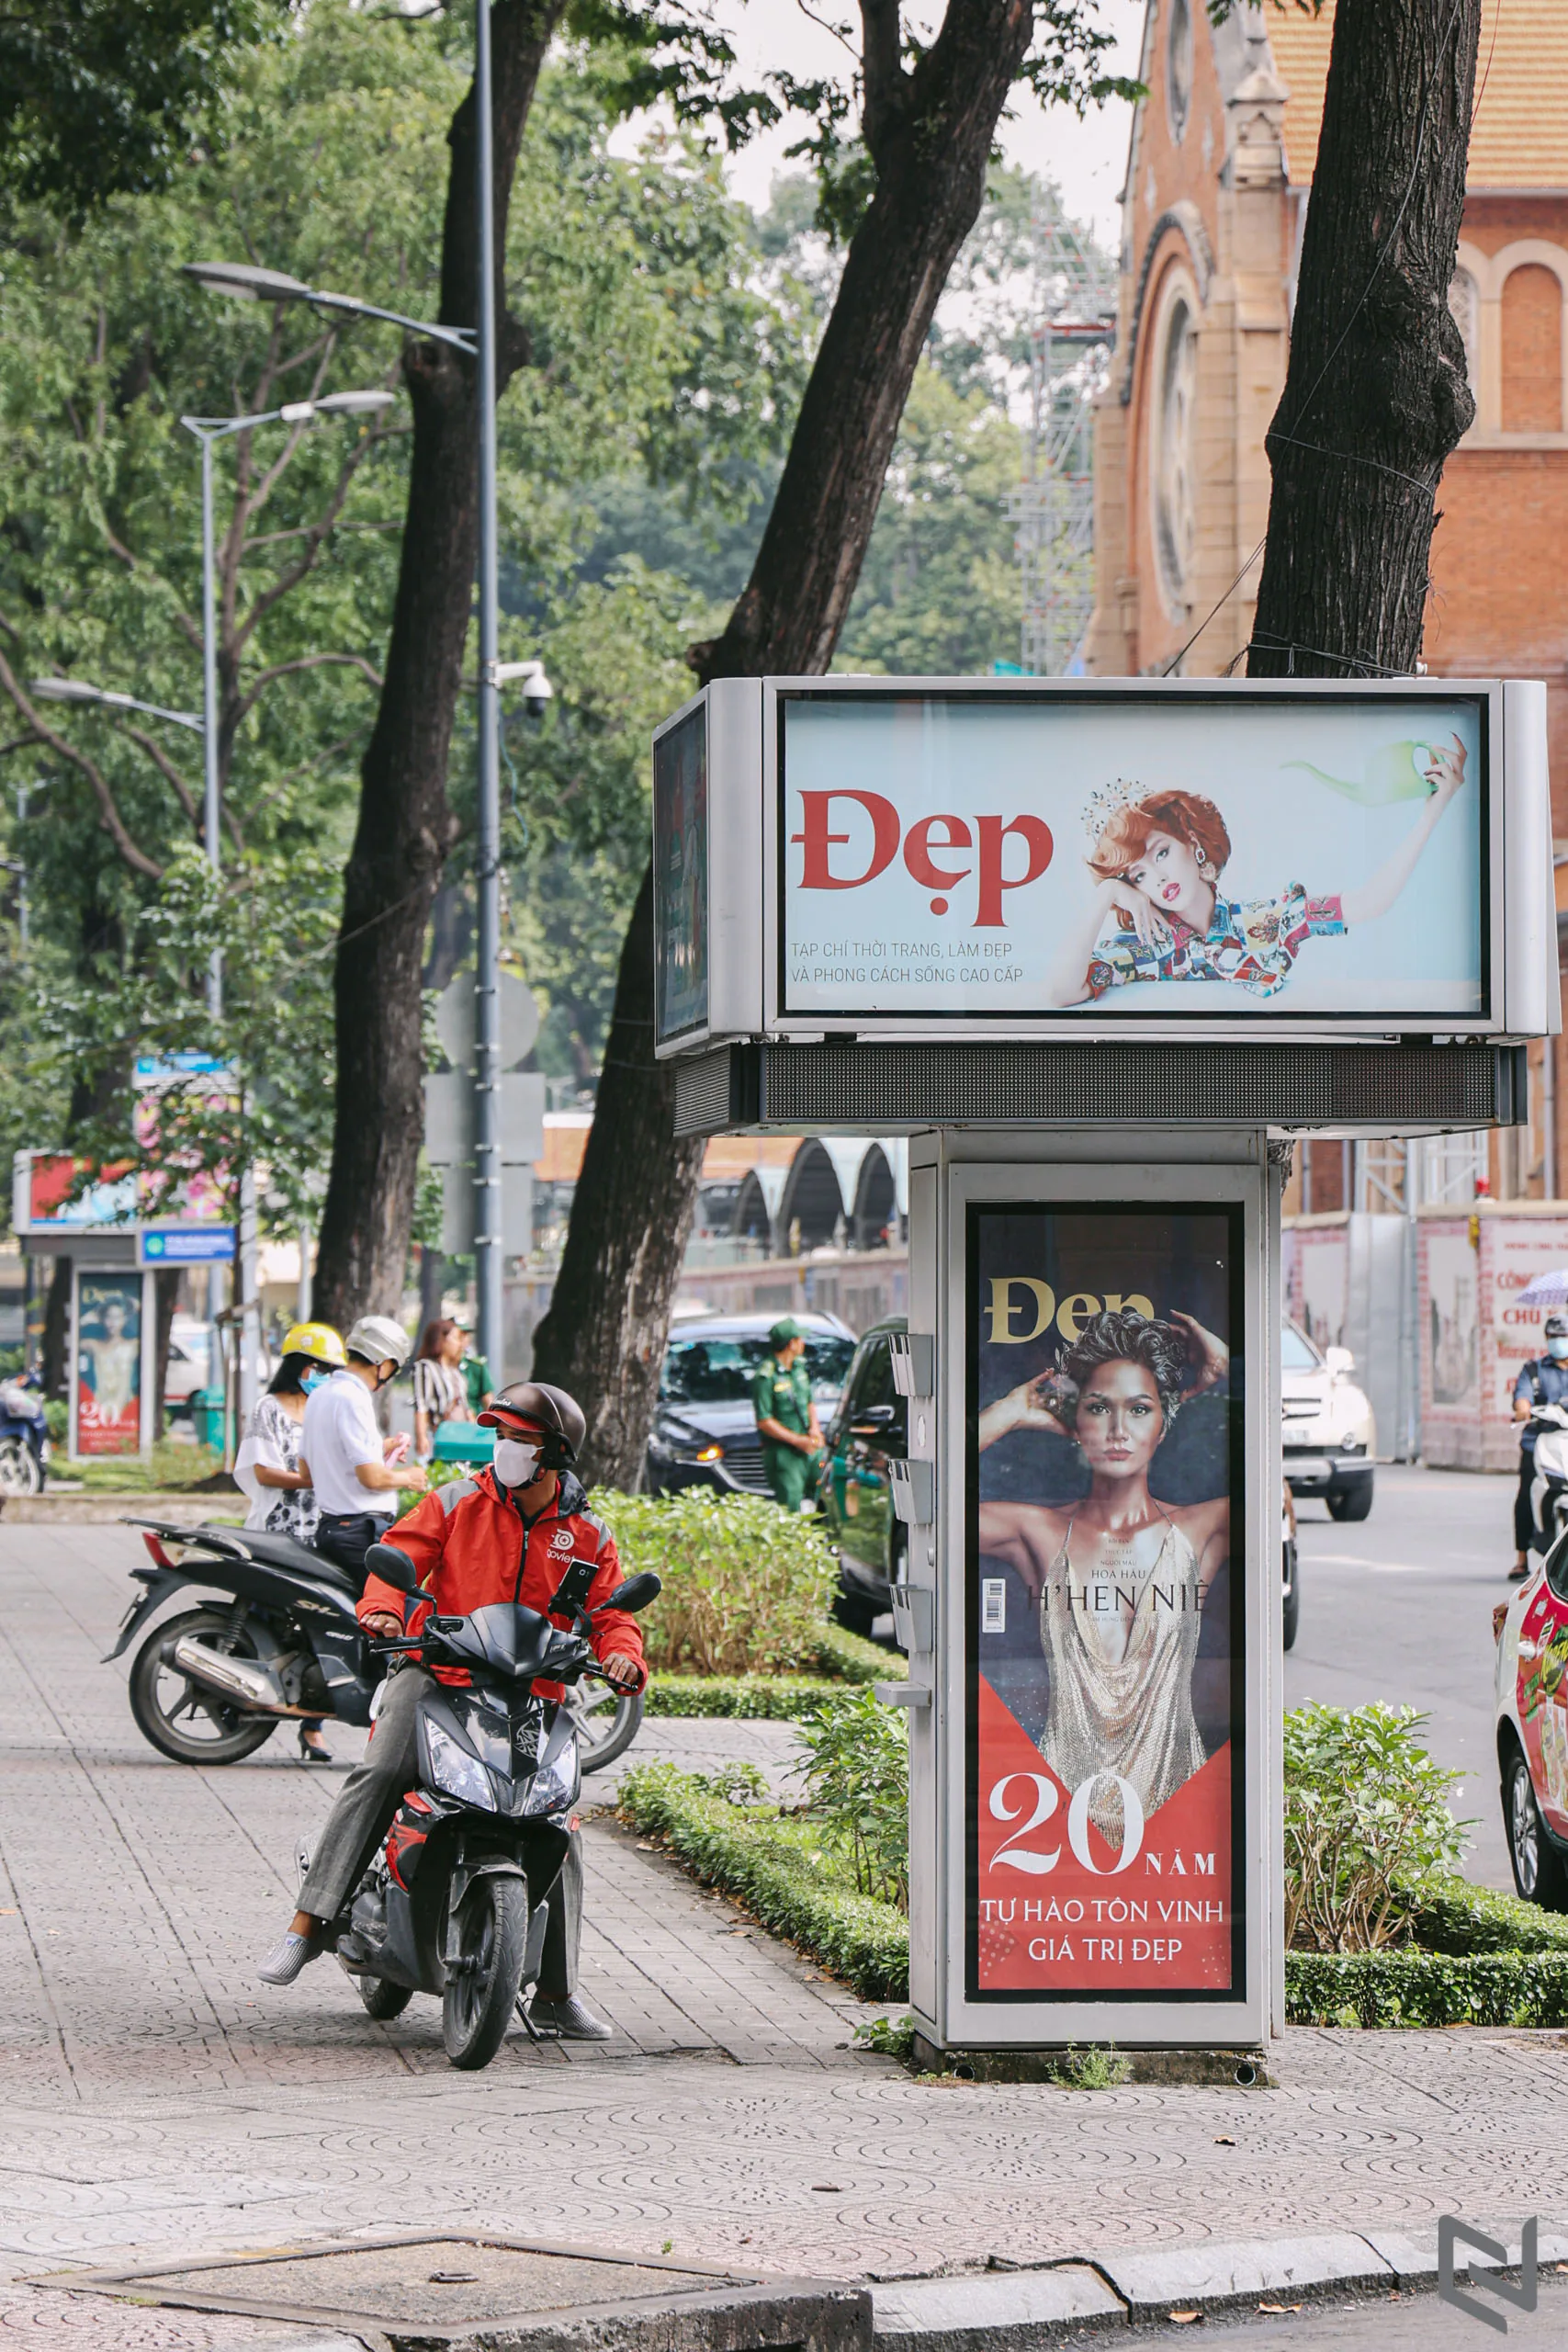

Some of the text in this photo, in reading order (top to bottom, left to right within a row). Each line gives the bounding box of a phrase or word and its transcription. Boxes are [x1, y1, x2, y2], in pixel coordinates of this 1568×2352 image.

[790, 788, 1055, 928] Đẹp
[791, 938, 1013, 959] TẠP CHÍ THỜI TRANG, LÀM ĐẸP
[791, 964, 1023, 983] VÀ PHONG CÁCH SỐNG CAO CẤP
[1090, 1569, 1117, 1579] HOA
[1151, 1579, 1210, 1612] NIÊ
[988, 1772, 1217, 1875] 20 NĂM
[980, 1895, 1224, 1927] TỰ HÀO TÔN VINH
[1028, 1935, 1183, 1964] GIÁ TRỊ ĐẸP
